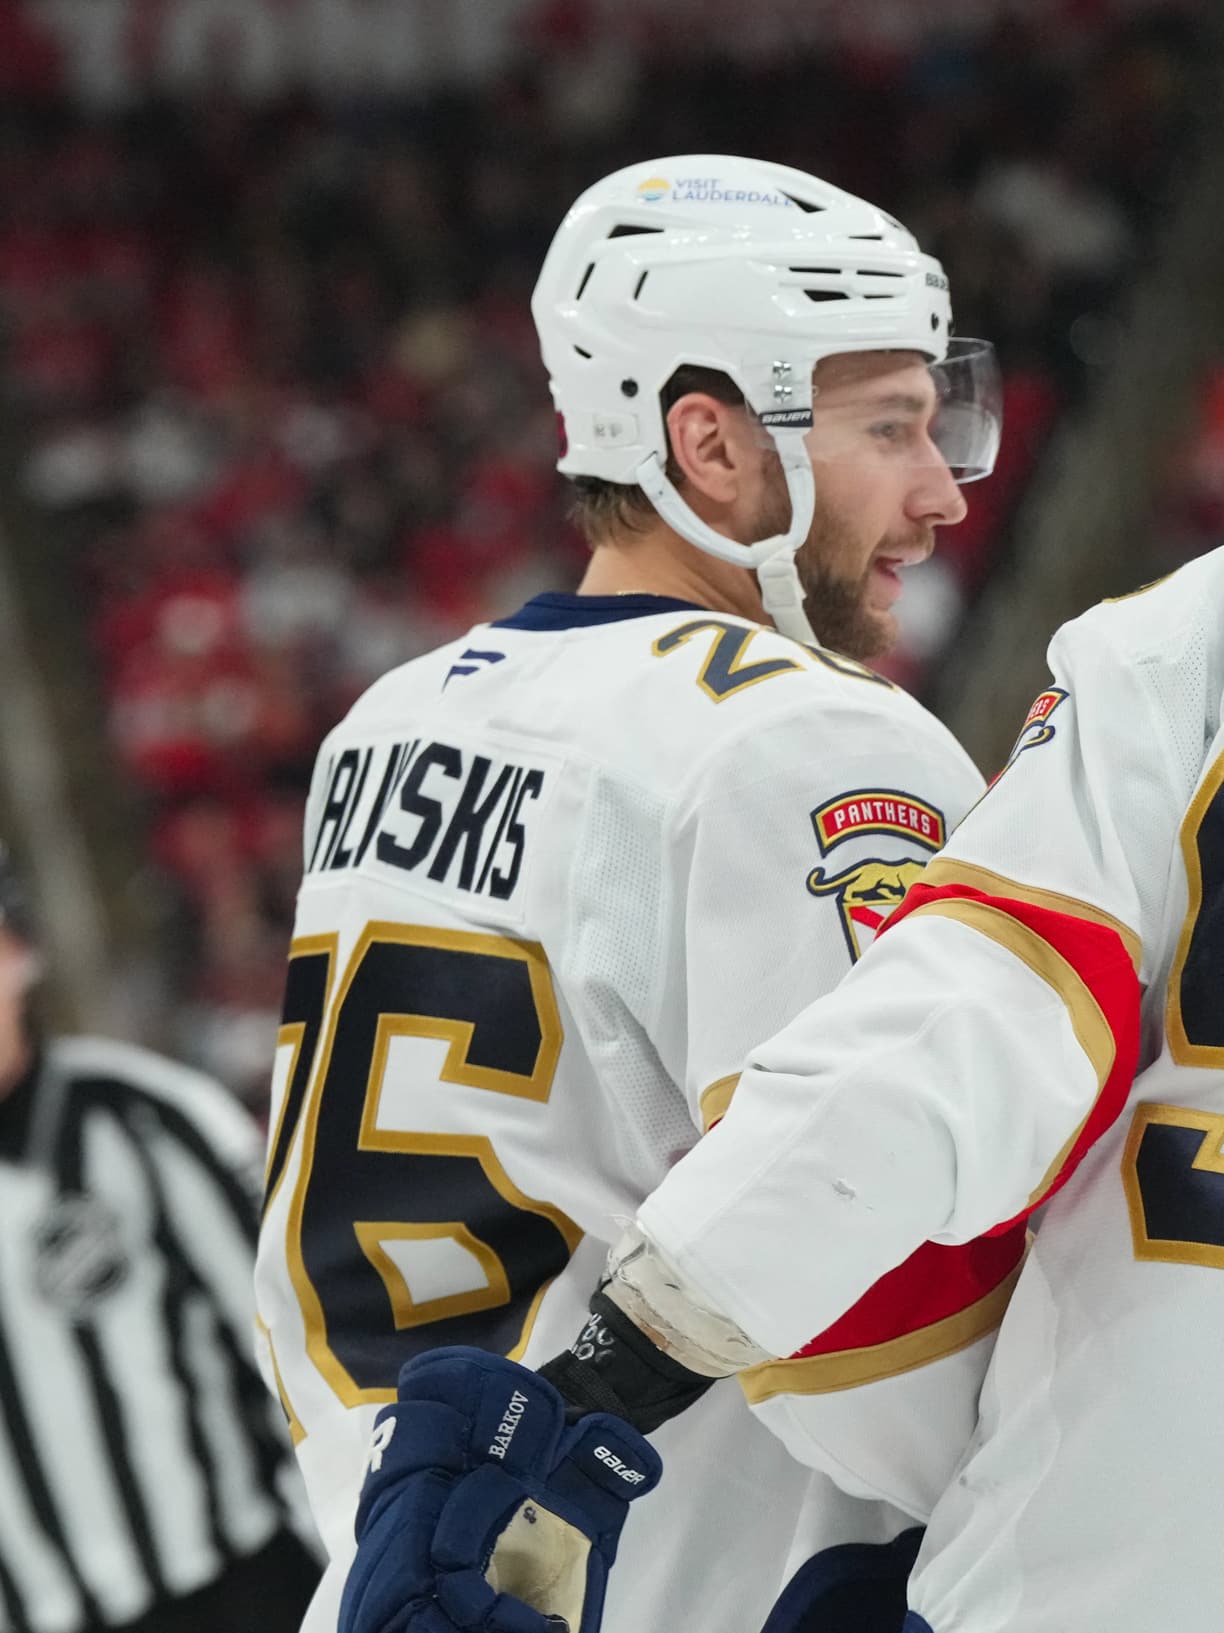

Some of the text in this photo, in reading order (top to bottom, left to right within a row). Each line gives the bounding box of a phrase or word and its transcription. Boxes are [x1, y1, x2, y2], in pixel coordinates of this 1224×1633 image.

[674, 179, 720, 189] VISIT
[761, 410, 811, 424] BAUER
[833, 801, 931, 835] PANTHERS
[488, 1390, 529, 1460] BARKOV
[593, 1445, 646, 1486] BAUER
